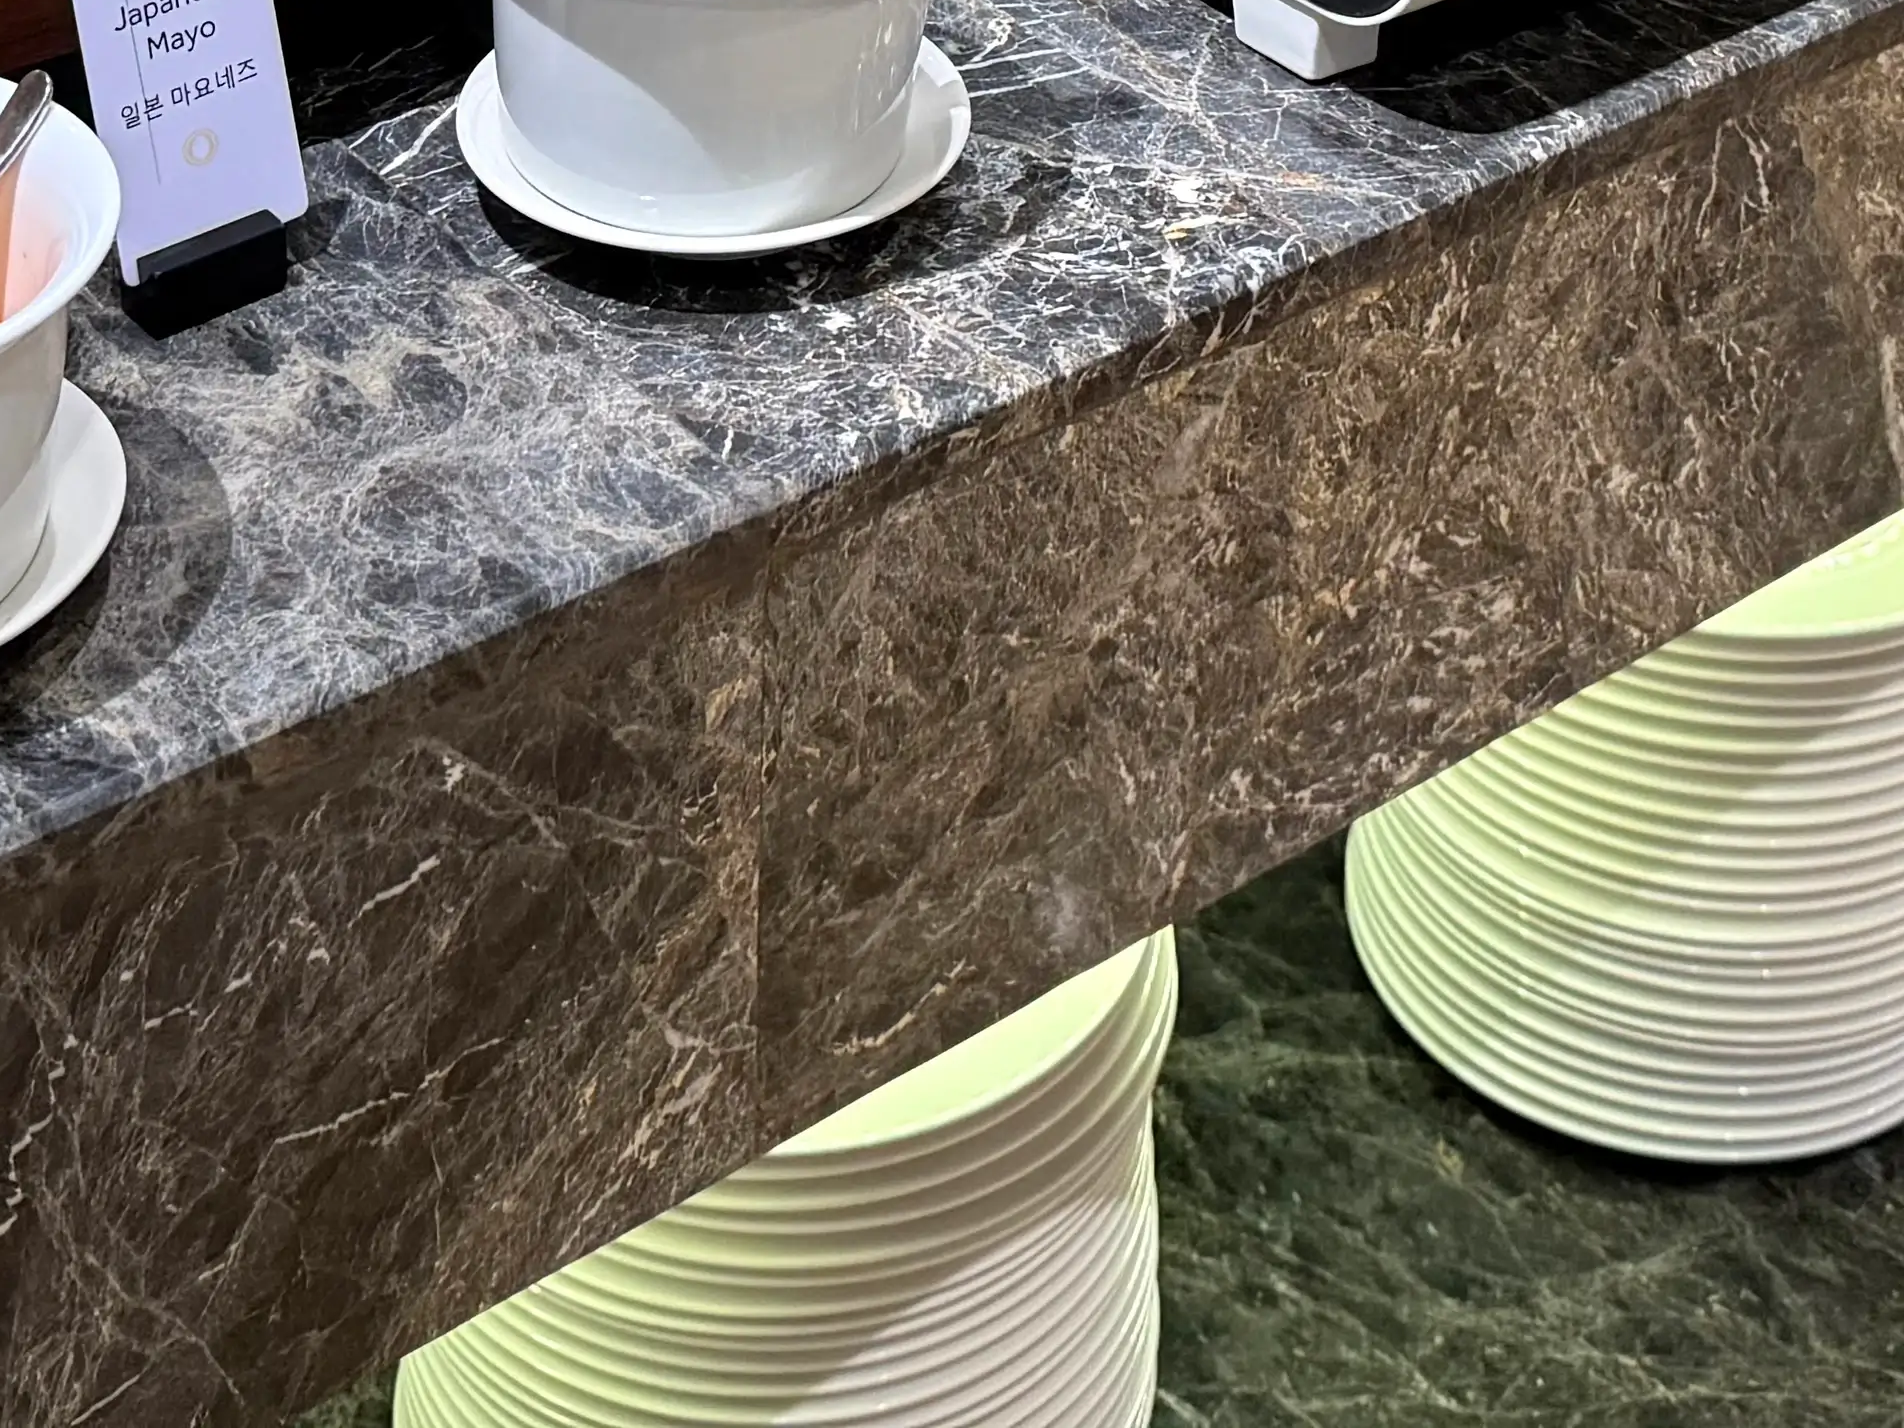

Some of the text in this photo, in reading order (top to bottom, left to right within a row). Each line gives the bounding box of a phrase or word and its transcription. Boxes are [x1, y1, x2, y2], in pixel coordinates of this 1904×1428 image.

[147, 18, 217, 60] Mayo
[120, 58, 258, 130] 일본 마요네즈
